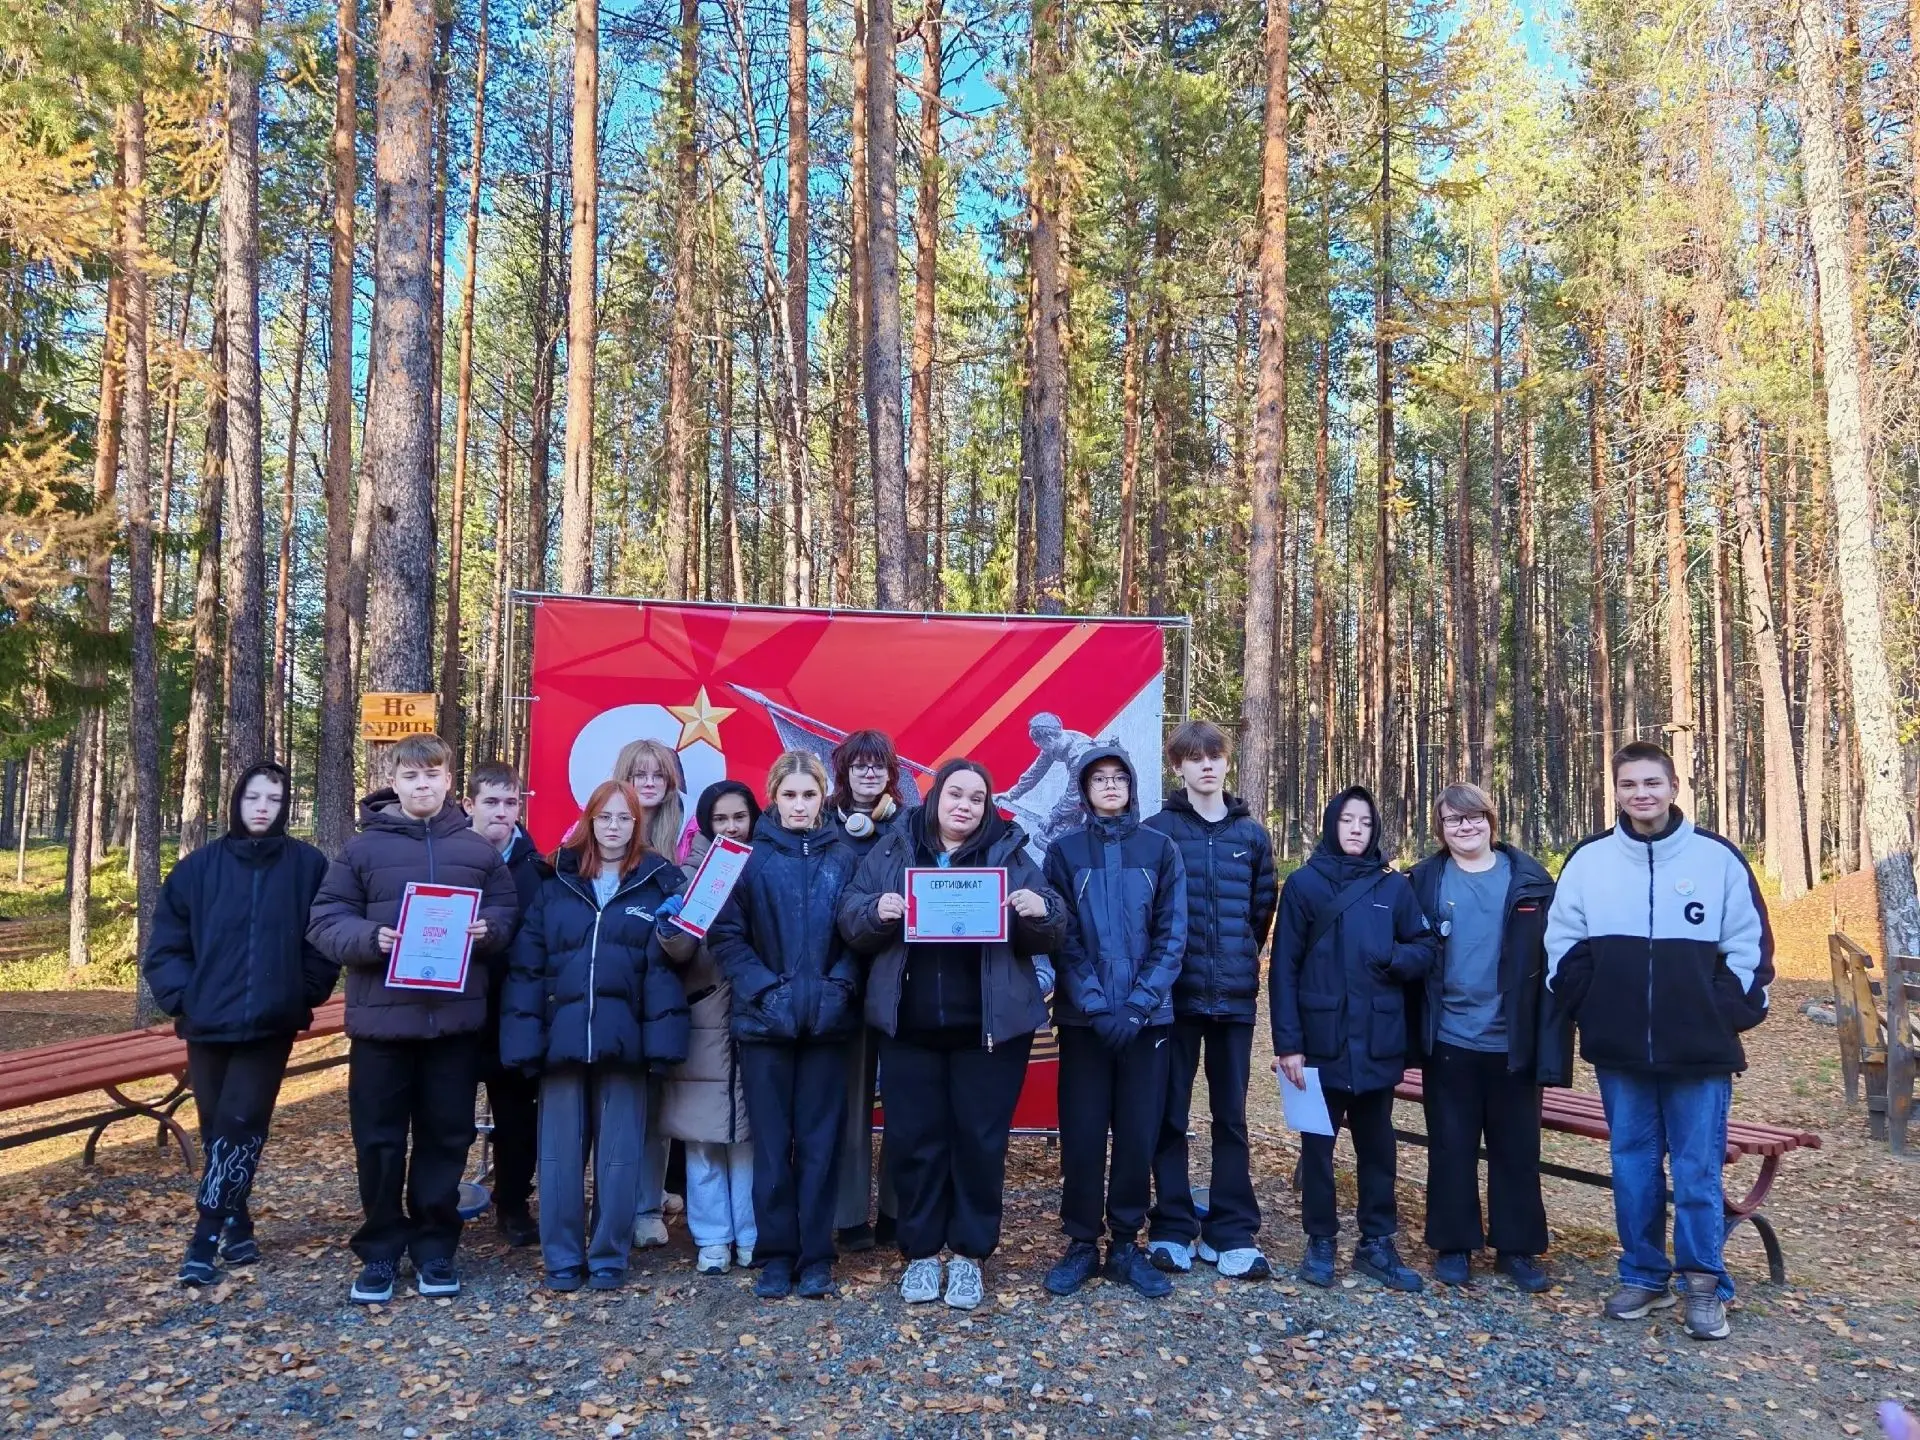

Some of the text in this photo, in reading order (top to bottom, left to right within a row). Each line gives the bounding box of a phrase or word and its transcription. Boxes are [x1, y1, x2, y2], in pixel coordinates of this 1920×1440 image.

[384, 698, 416, 716] Не
[930, 880, 983, 890] СЕРТИФИКАТ
[1684, 901, 1705, 925] G
